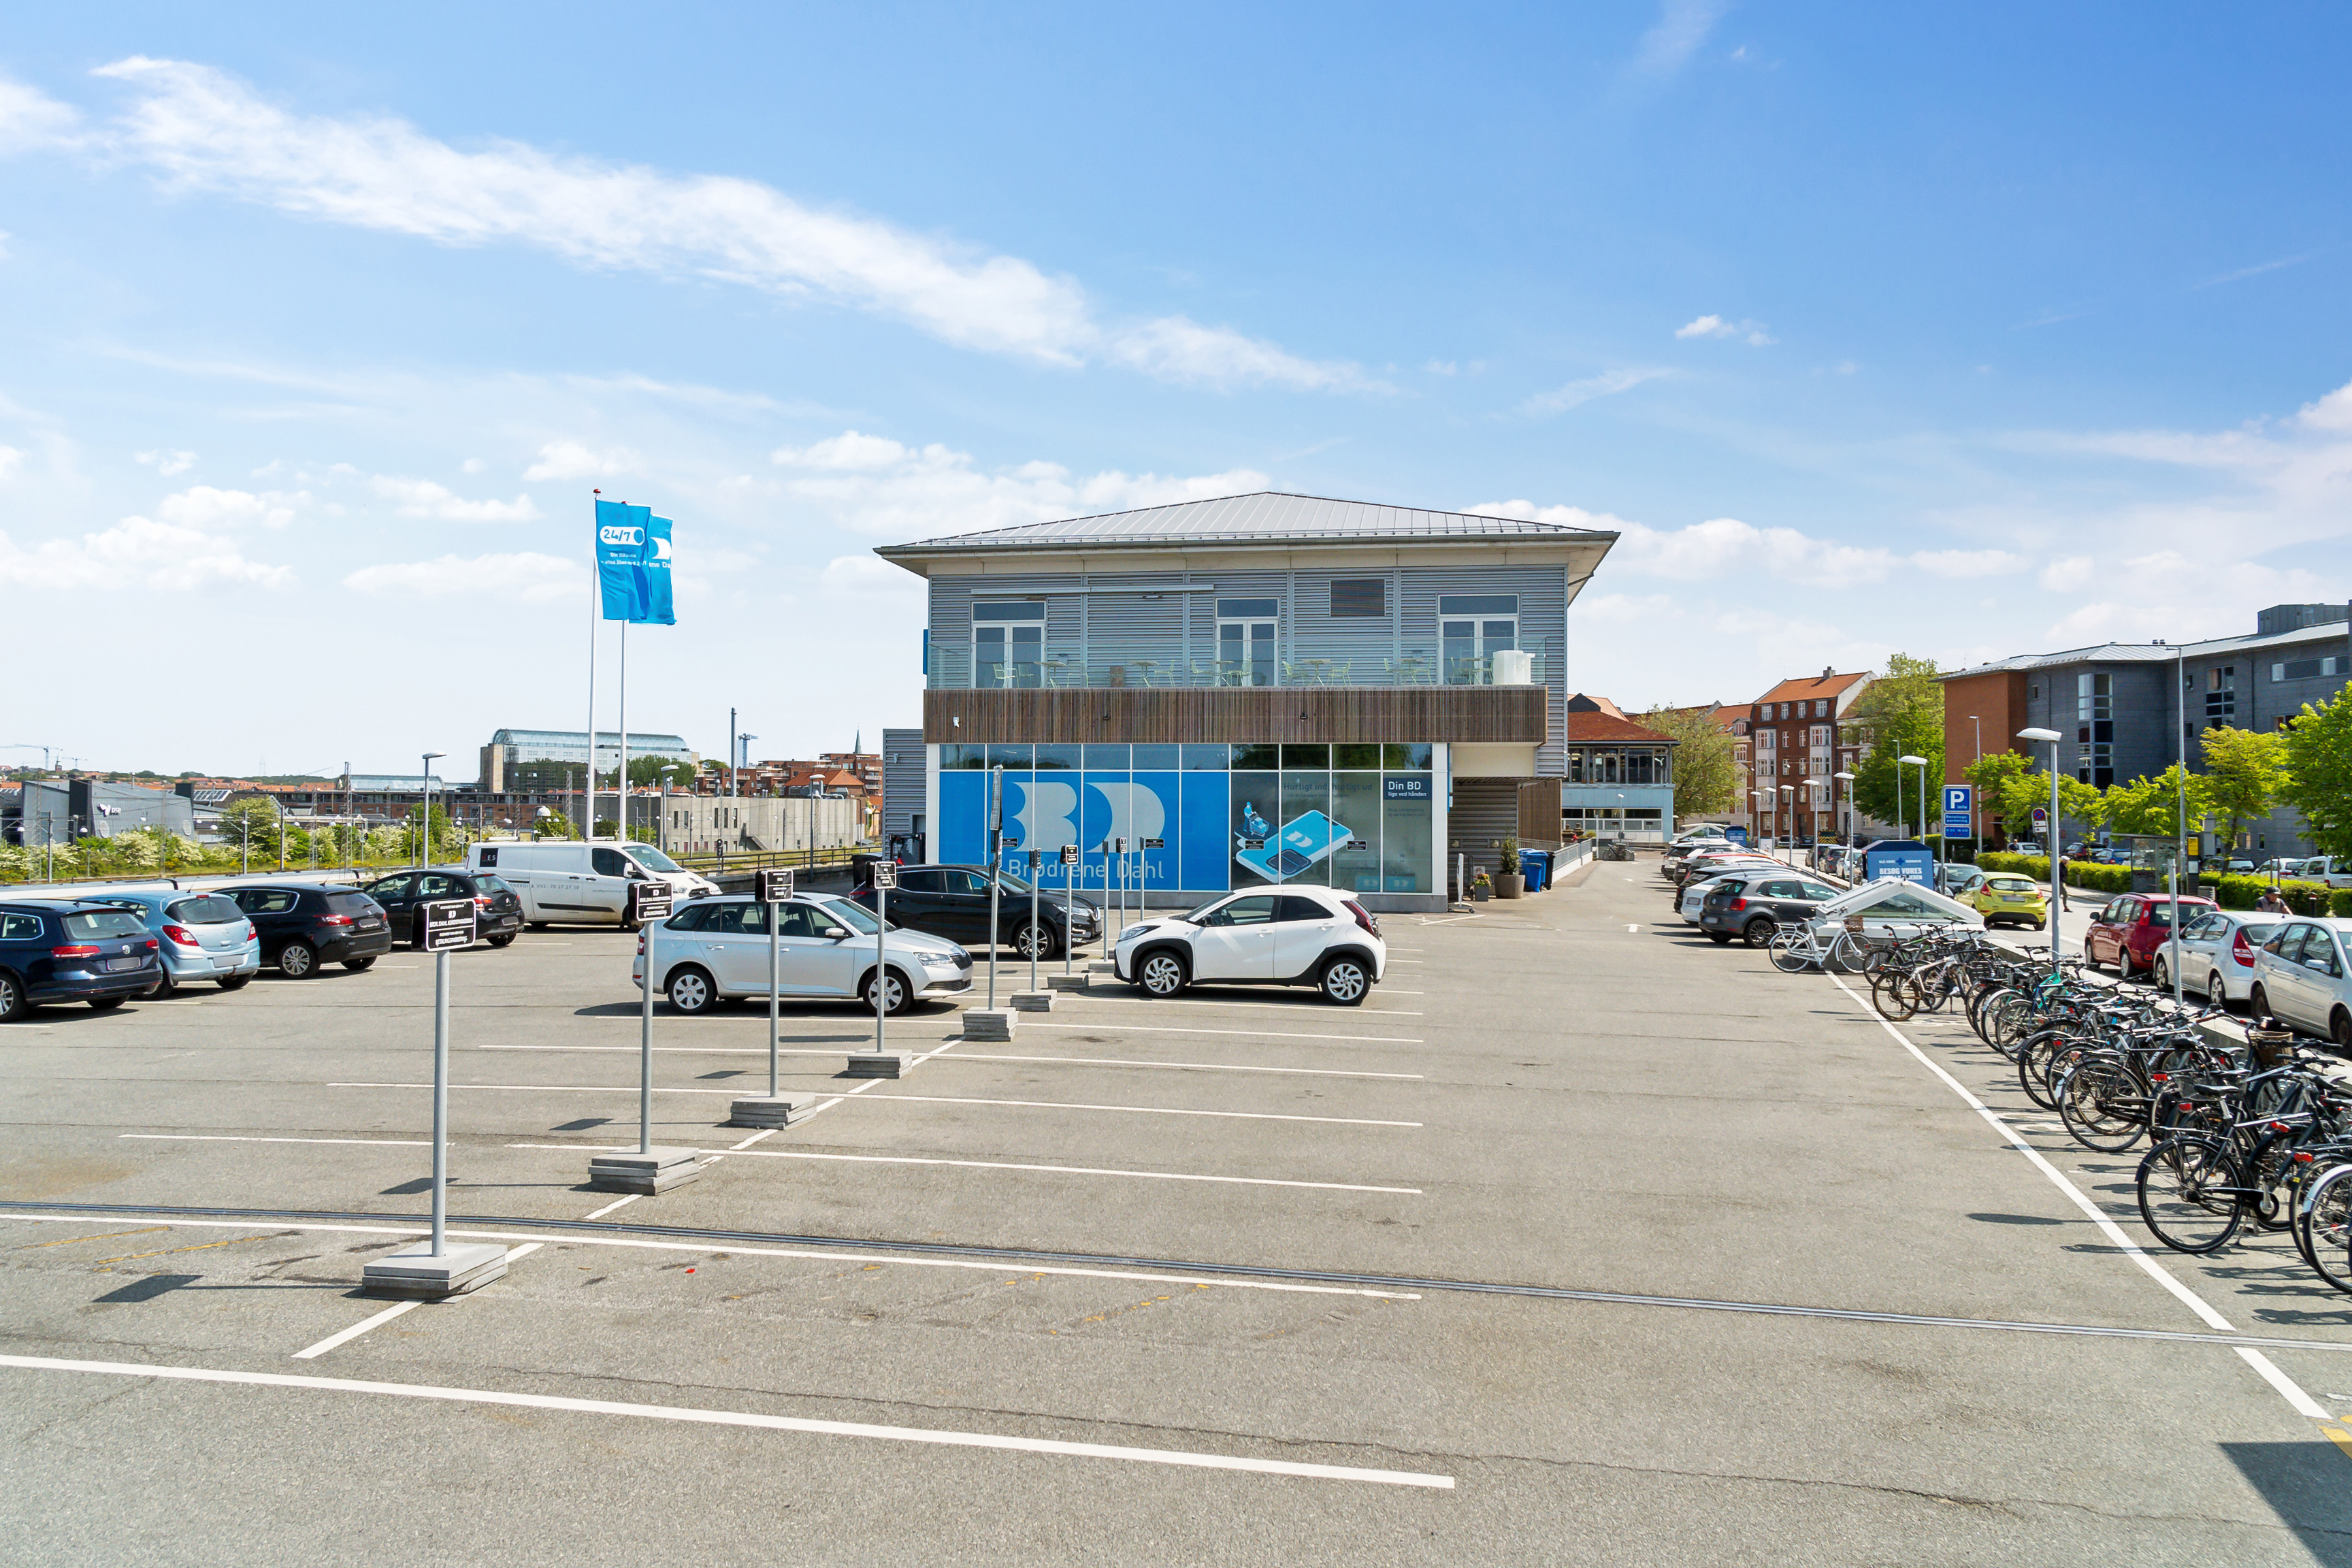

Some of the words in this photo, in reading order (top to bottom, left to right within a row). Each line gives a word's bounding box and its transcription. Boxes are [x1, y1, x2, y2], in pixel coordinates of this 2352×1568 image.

[604, 529, 631, 542] 24/7
[1284, 783, 1312, 791] Hurtigt
[1362, 783, 1373, 791] ud
[1388, 781, 1404, 790] Din
[1407, 781, 1421, 790] BD
[1950, 790, 1965, 809] P
[1011, 781, 1166, 853] BD
[1009, 859, 1105, 879] Brødrene
[1117, 860, 1164, 879] Dahl
